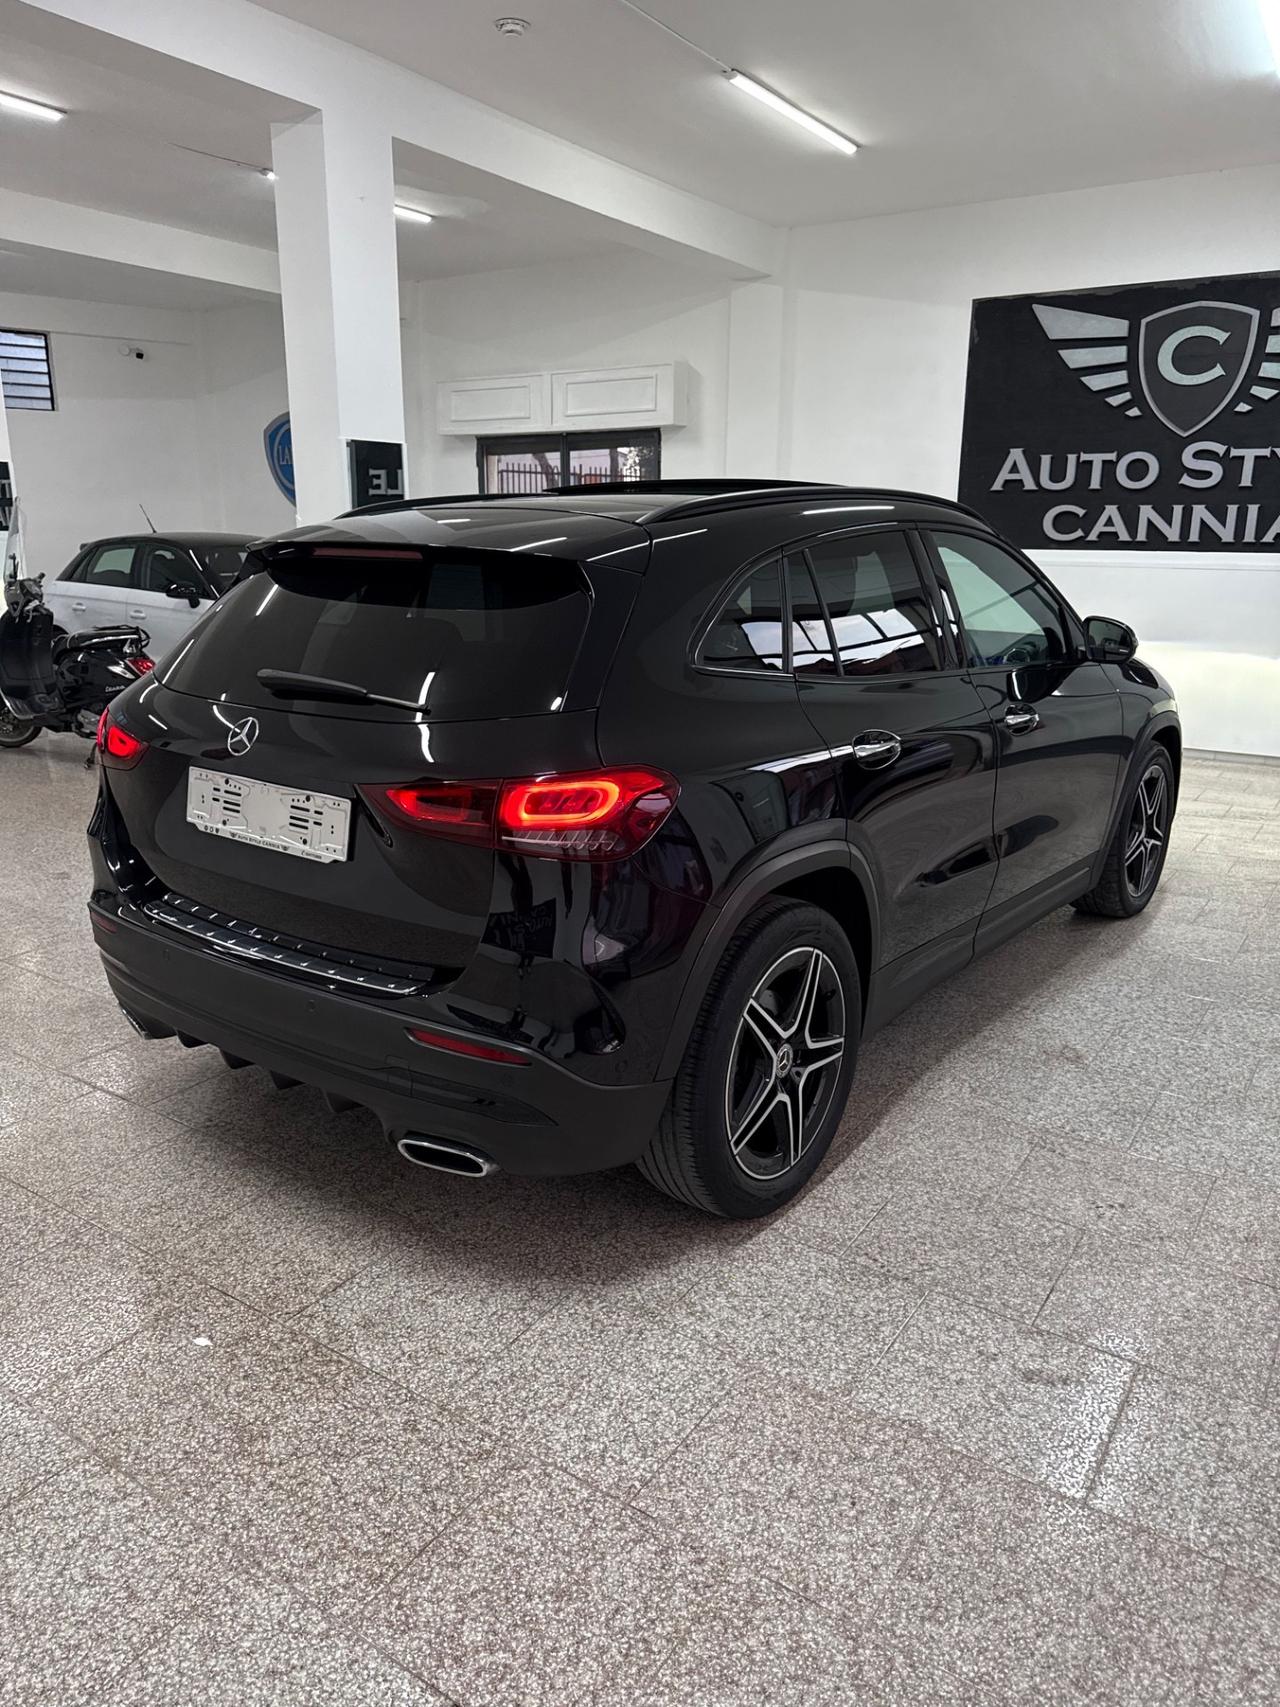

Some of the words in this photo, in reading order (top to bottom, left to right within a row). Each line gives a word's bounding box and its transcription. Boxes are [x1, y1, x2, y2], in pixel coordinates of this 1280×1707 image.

[1158, 325, 1231, 385] C
[279, 445, 294, 465] LA
[1178, 440, 1280, 489] ST
